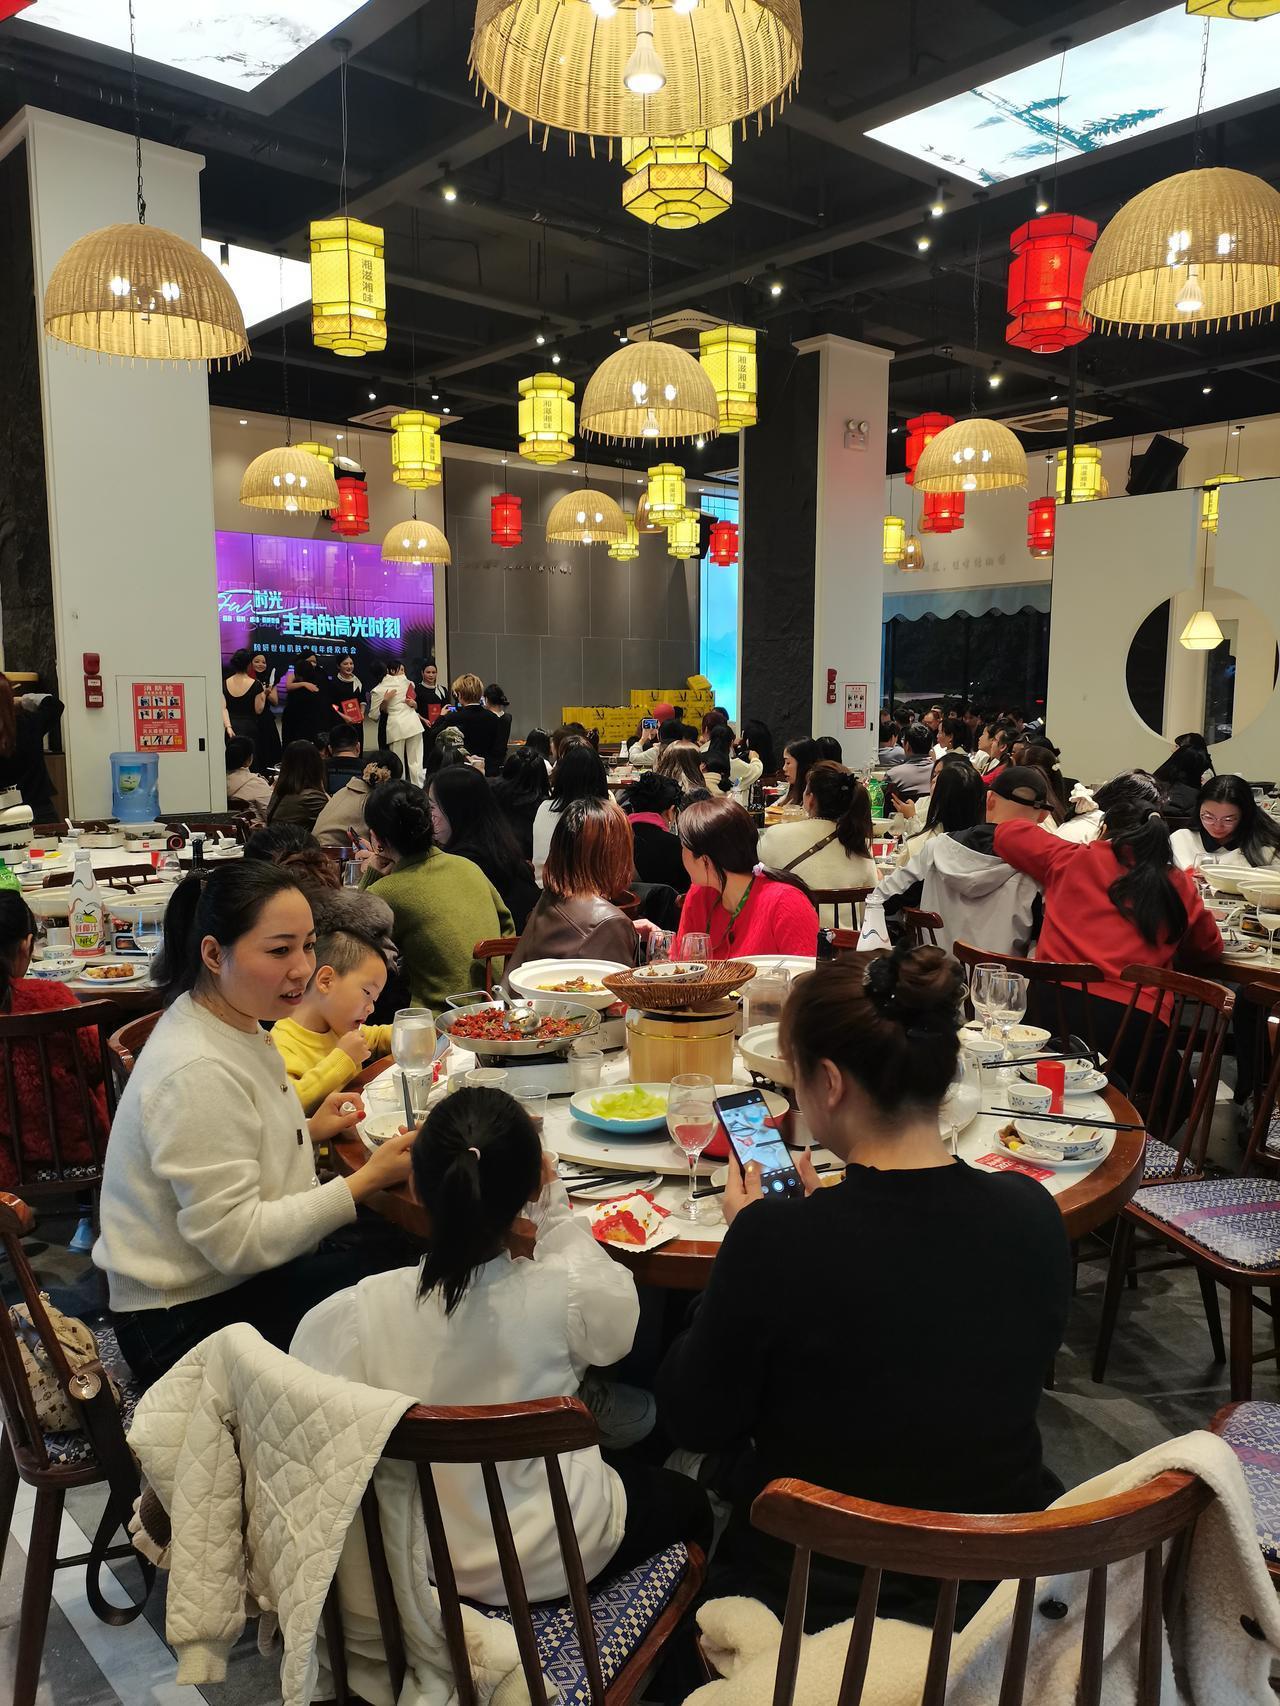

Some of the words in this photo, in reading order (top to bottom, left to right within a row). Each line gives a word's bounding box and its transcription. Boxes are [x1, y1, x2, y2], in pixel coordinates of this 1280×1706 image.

[254, 589, 283, 609] 时光
[282, 612, 400, 639] 主角的高光时刻
